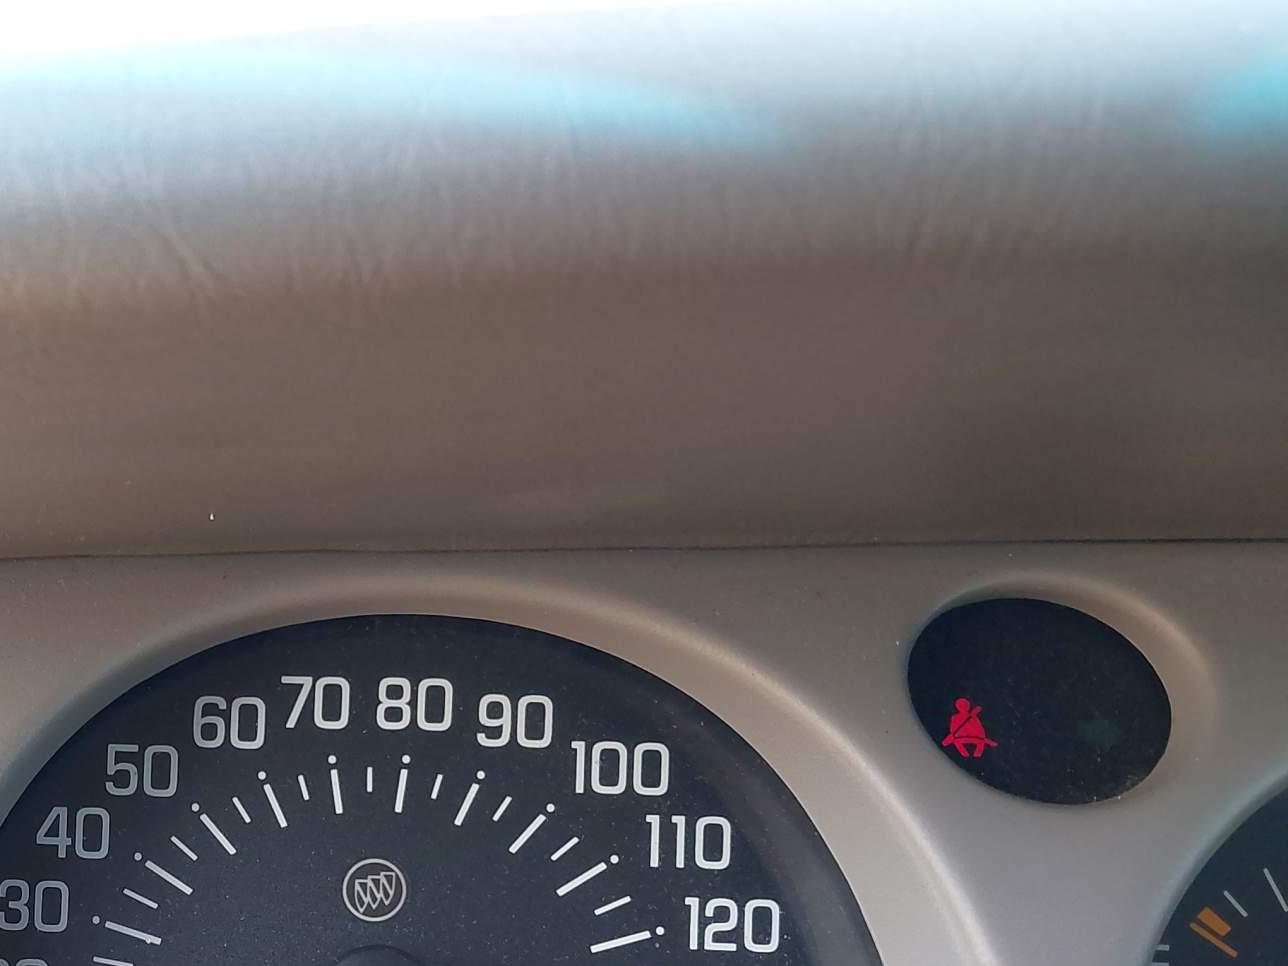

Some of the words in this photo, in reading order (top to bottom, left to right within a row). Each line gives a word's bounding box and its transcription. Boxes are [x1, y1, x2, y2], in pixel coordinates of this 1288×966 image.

[193, 695, 267, 749] 60
[281, 676, 350, 730] 70
[375, 677, 453, 731] 80
[476, 694, 553, 749] 90
[105, 743, 179, 798] 50
[571, 741, 670, 796] 100
[36, 806, 110, 859] 40
[645, 814, 731, 870] 110
[685, 896, 780, 953] 120
